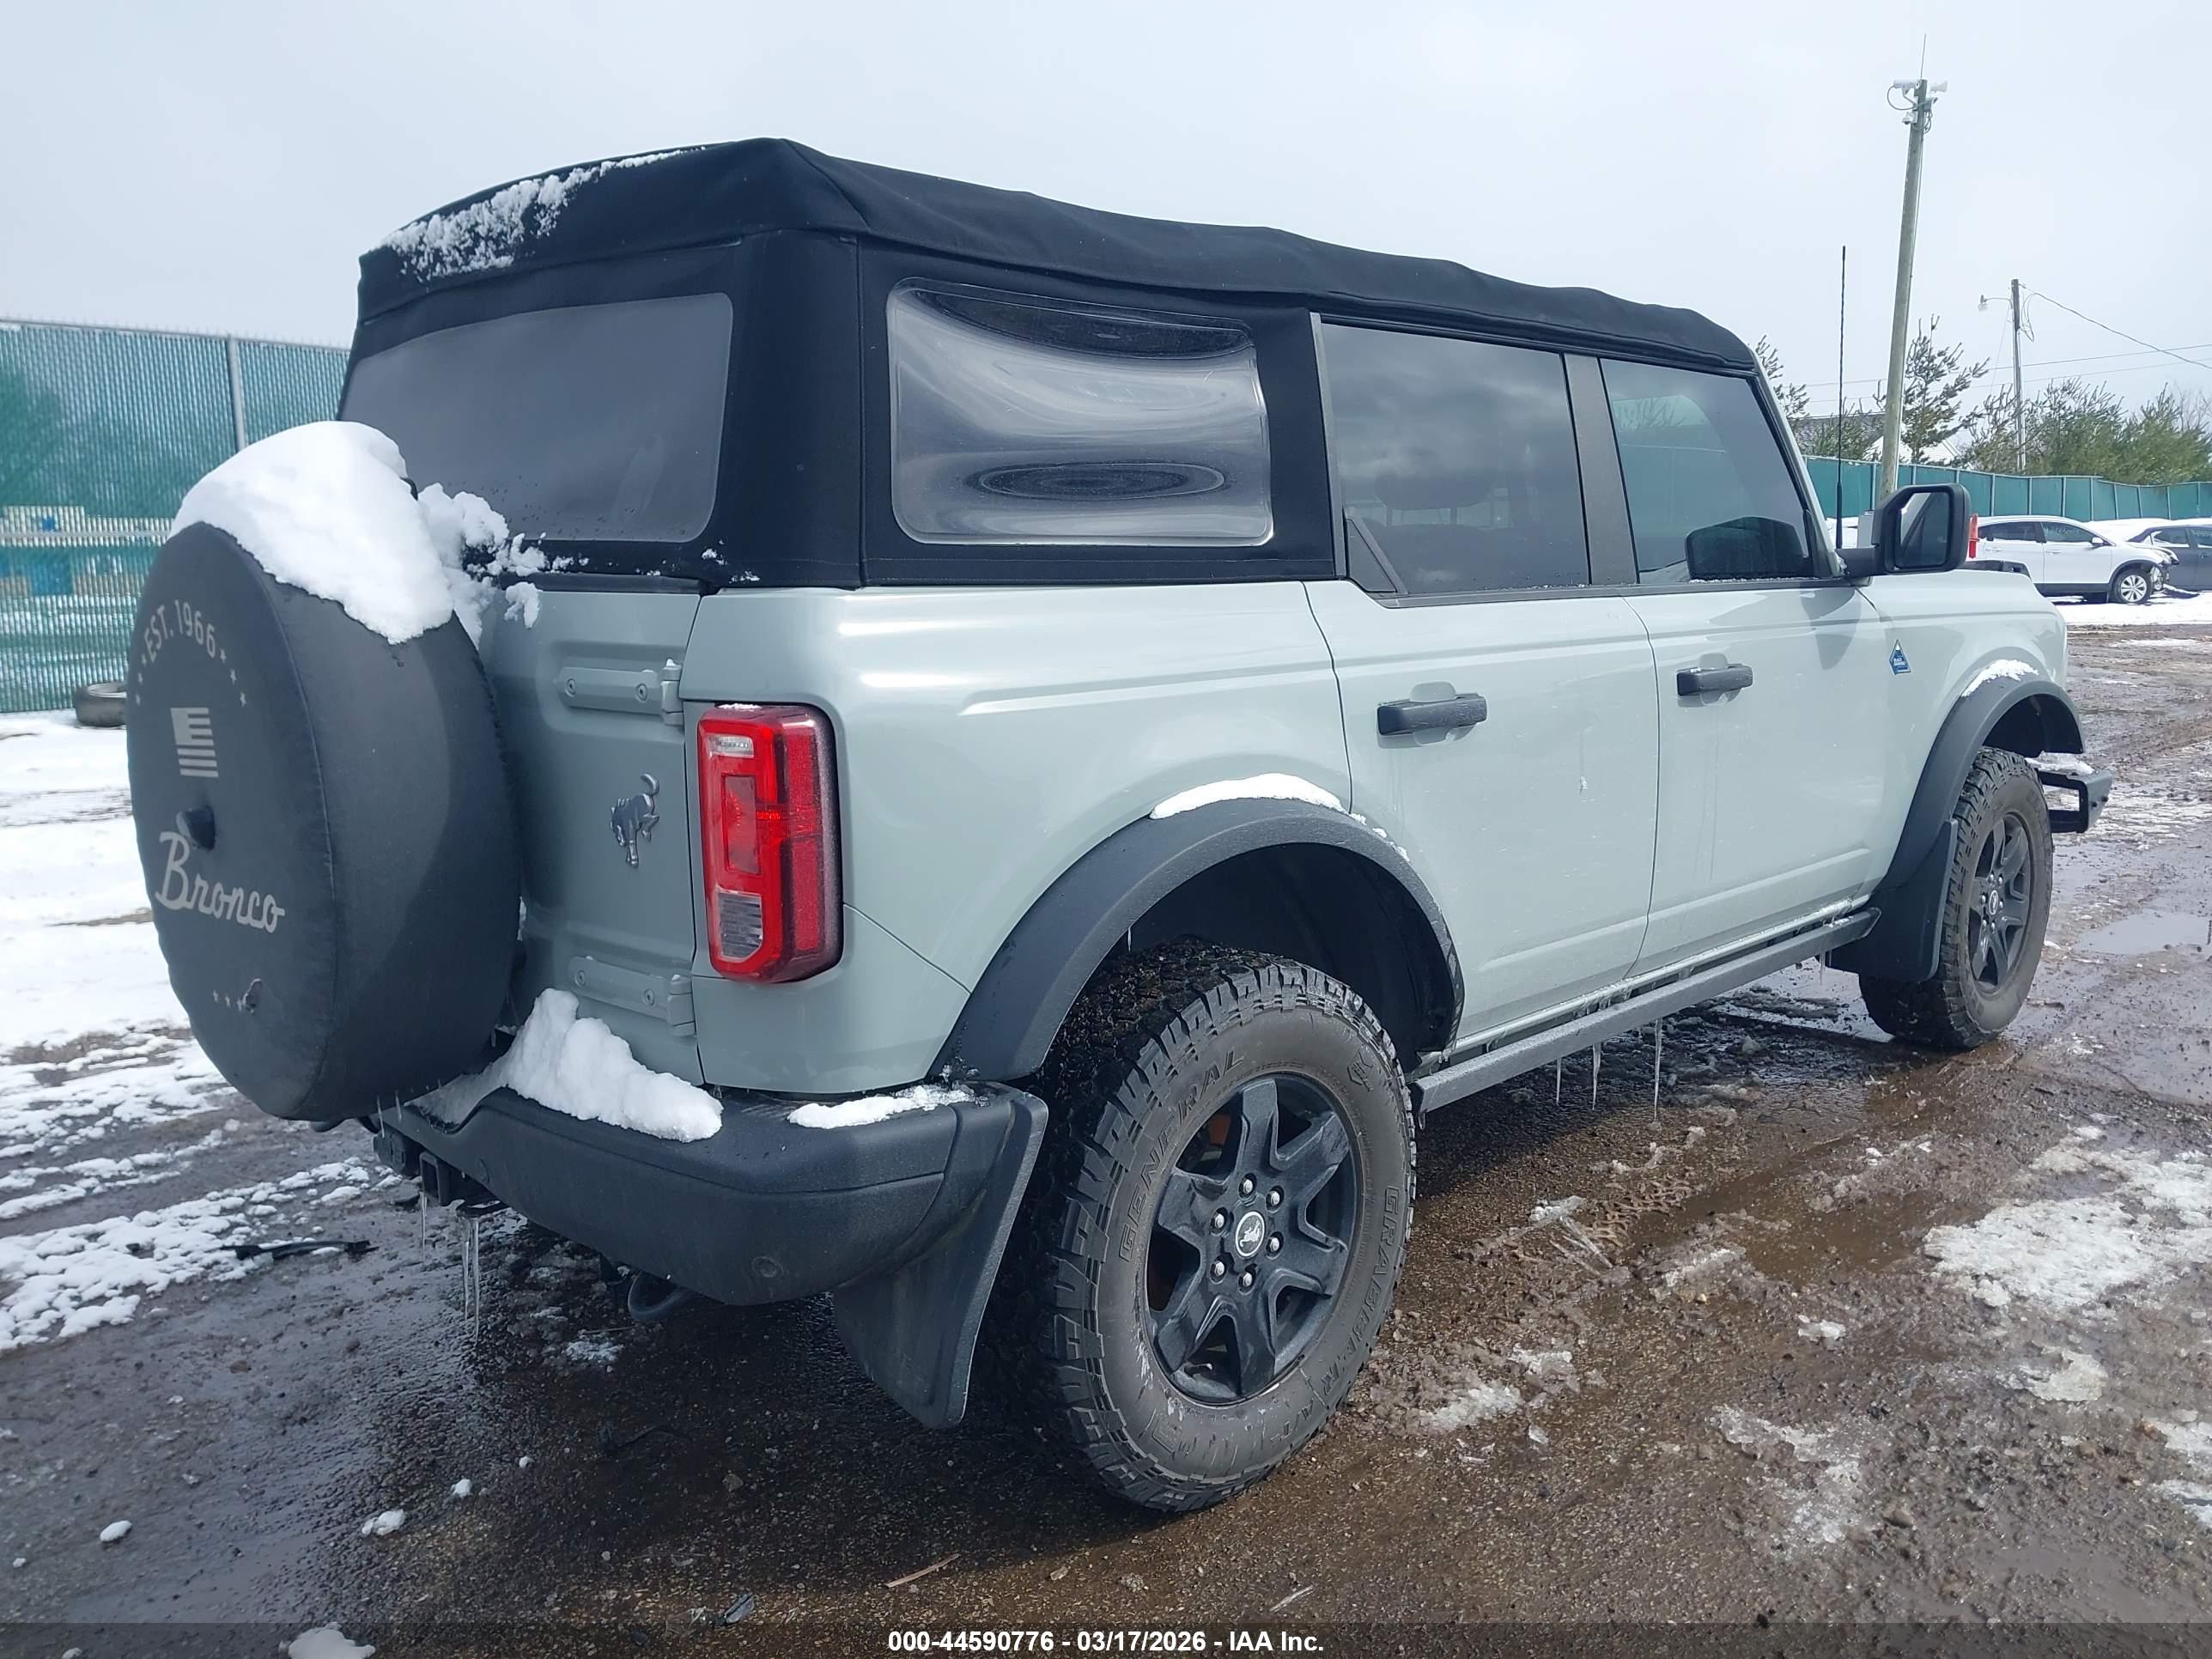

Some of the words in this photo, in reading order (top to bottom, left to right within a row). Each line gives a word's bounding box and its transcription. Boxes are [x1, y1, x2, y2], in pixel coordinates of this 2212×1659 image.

[143, 605, 173, 663] EST.
[175, 599, 216, 659] 1966
[155, 830, 285, 933] Bronco
